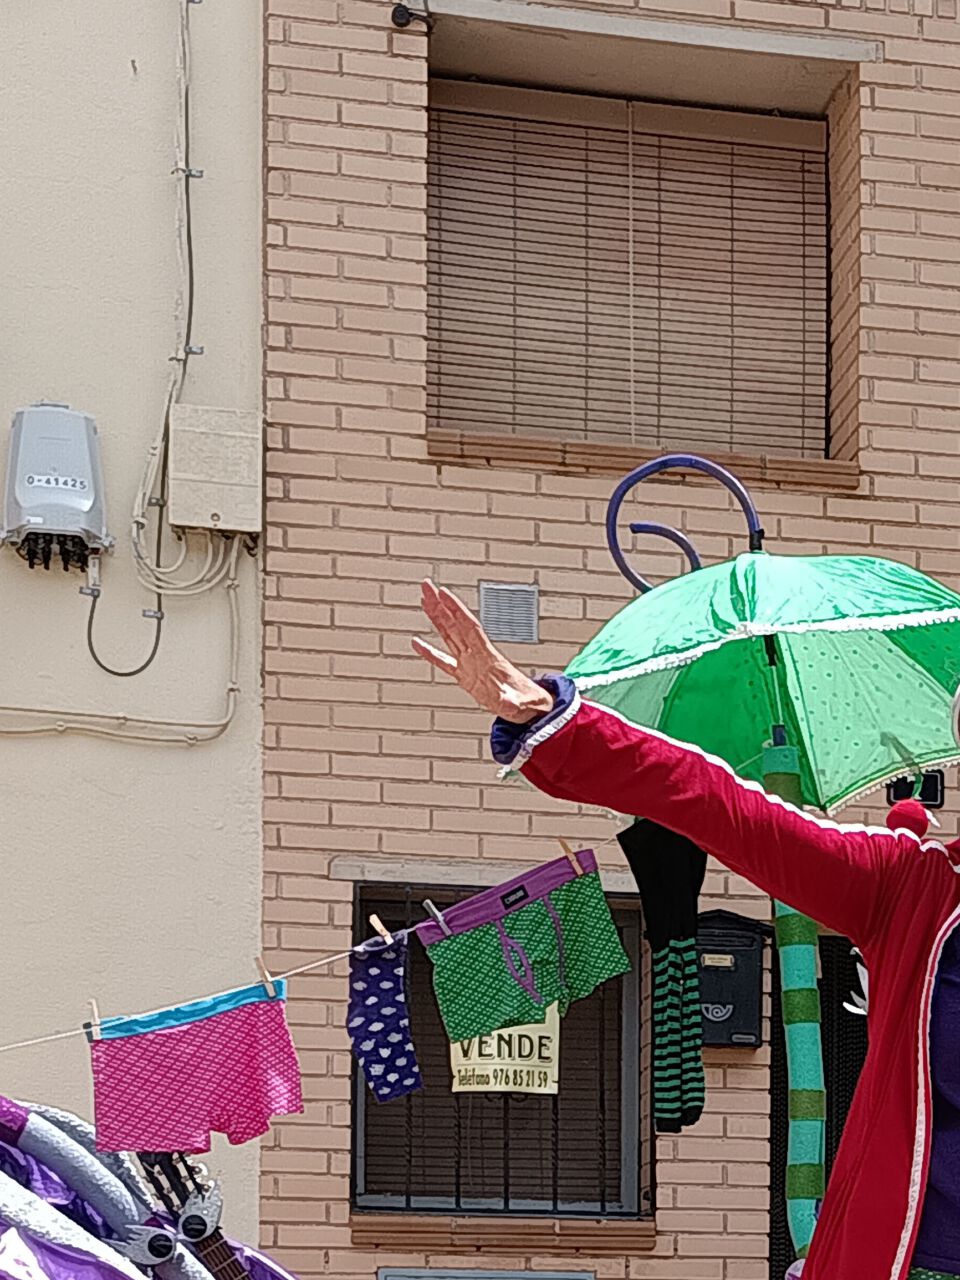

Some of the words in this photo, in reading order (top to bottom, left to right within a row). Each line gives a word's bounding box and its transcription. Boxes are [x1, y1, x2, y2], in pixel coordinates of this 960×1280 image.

[459, 1033, 553, 1063] VENDE
[493, 1068, 511, 1086] 976
[513, 1069, 524, 1087] 85
[526, 1070, 535, 1087] 21
[538, 1070, 548, 1088] 59
